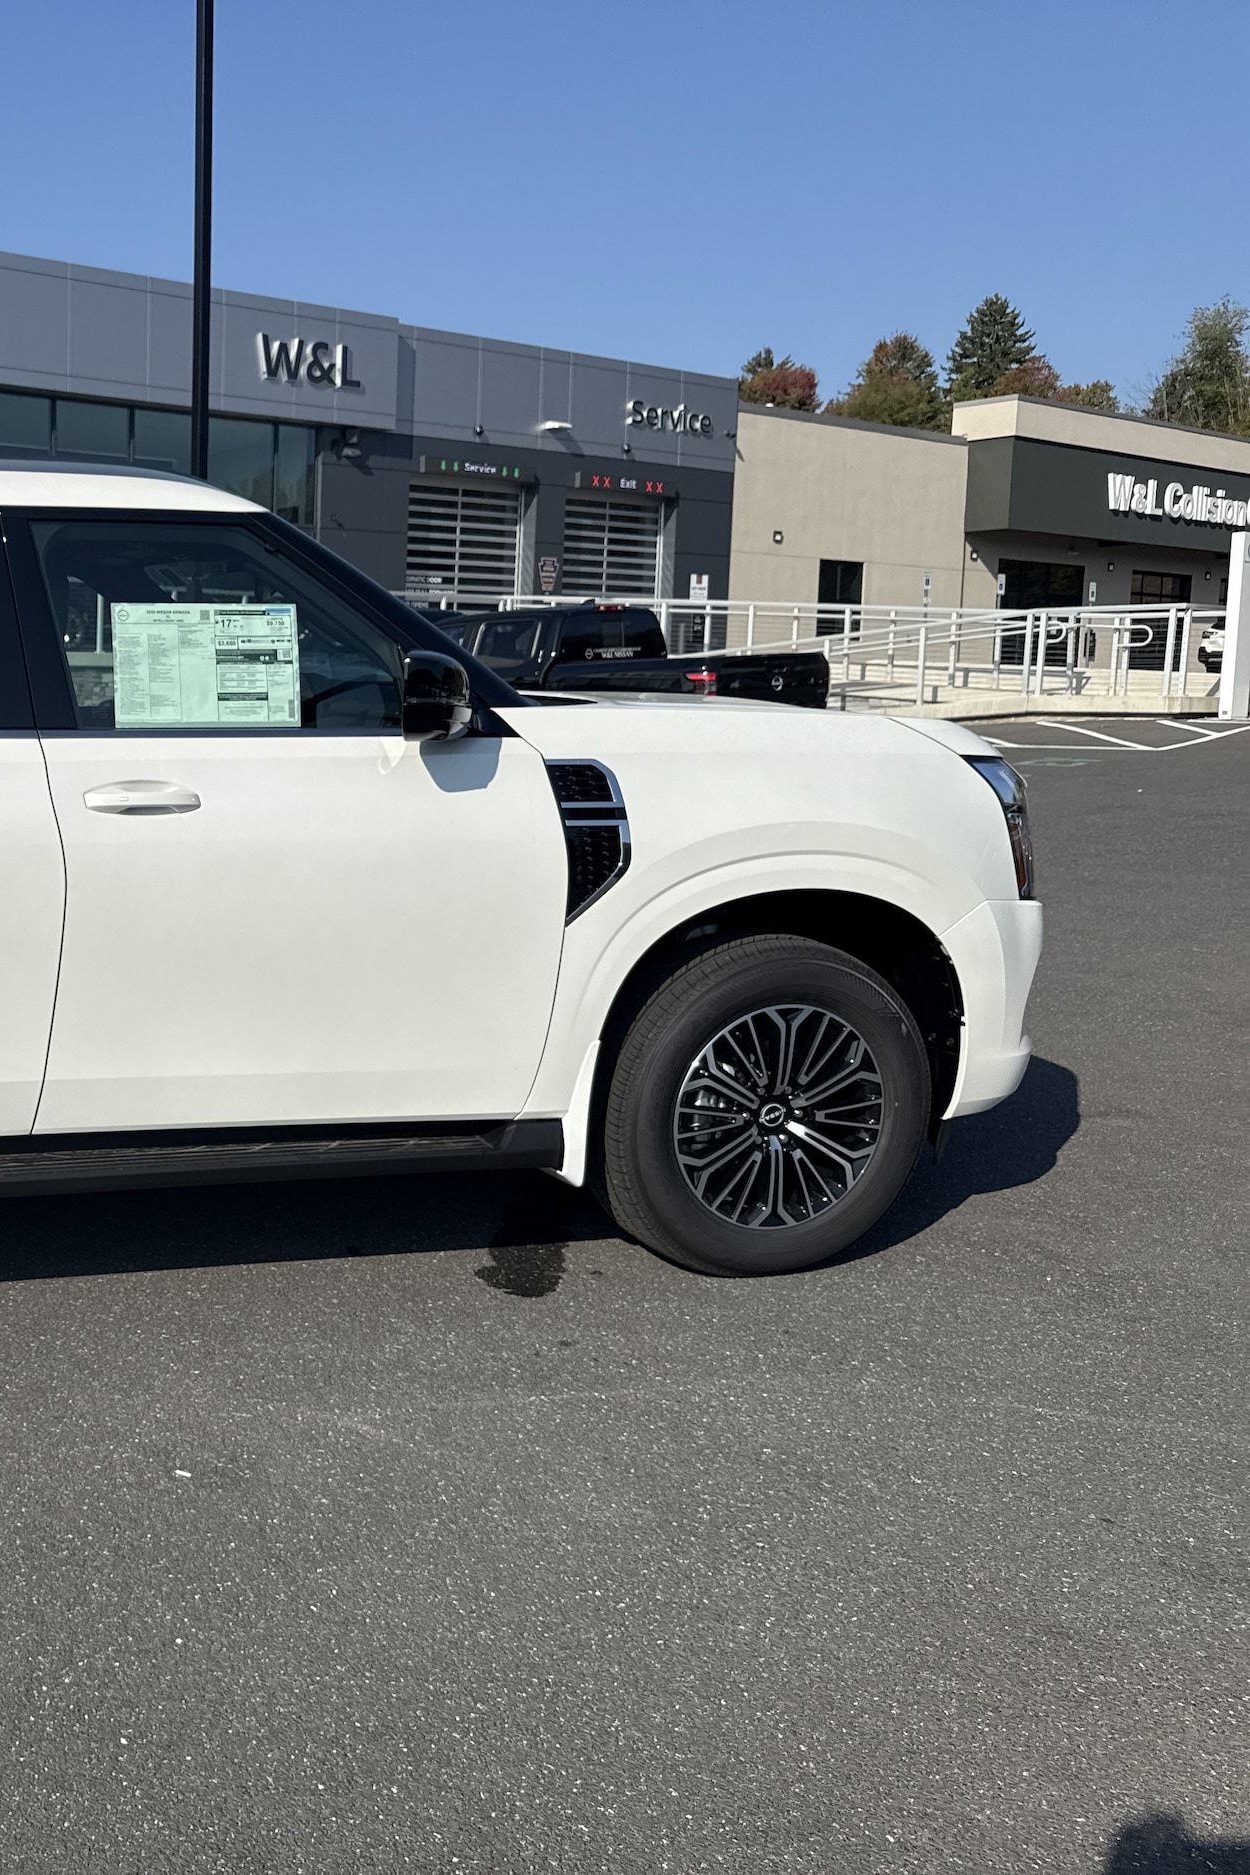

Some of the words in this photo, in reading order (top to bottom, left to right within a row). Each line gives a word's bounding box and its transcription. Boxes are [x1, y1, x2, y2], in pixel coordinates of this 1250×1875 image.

[257, 332, 361, 388] W&L
[626, 401, 711, 433] Service
[620, 478, 636, 489] Exit
[1108, 472, 1163, 516] W&L
[1164, 482, 1246, 526] Collision
[221, 619, 231, 628] 17
